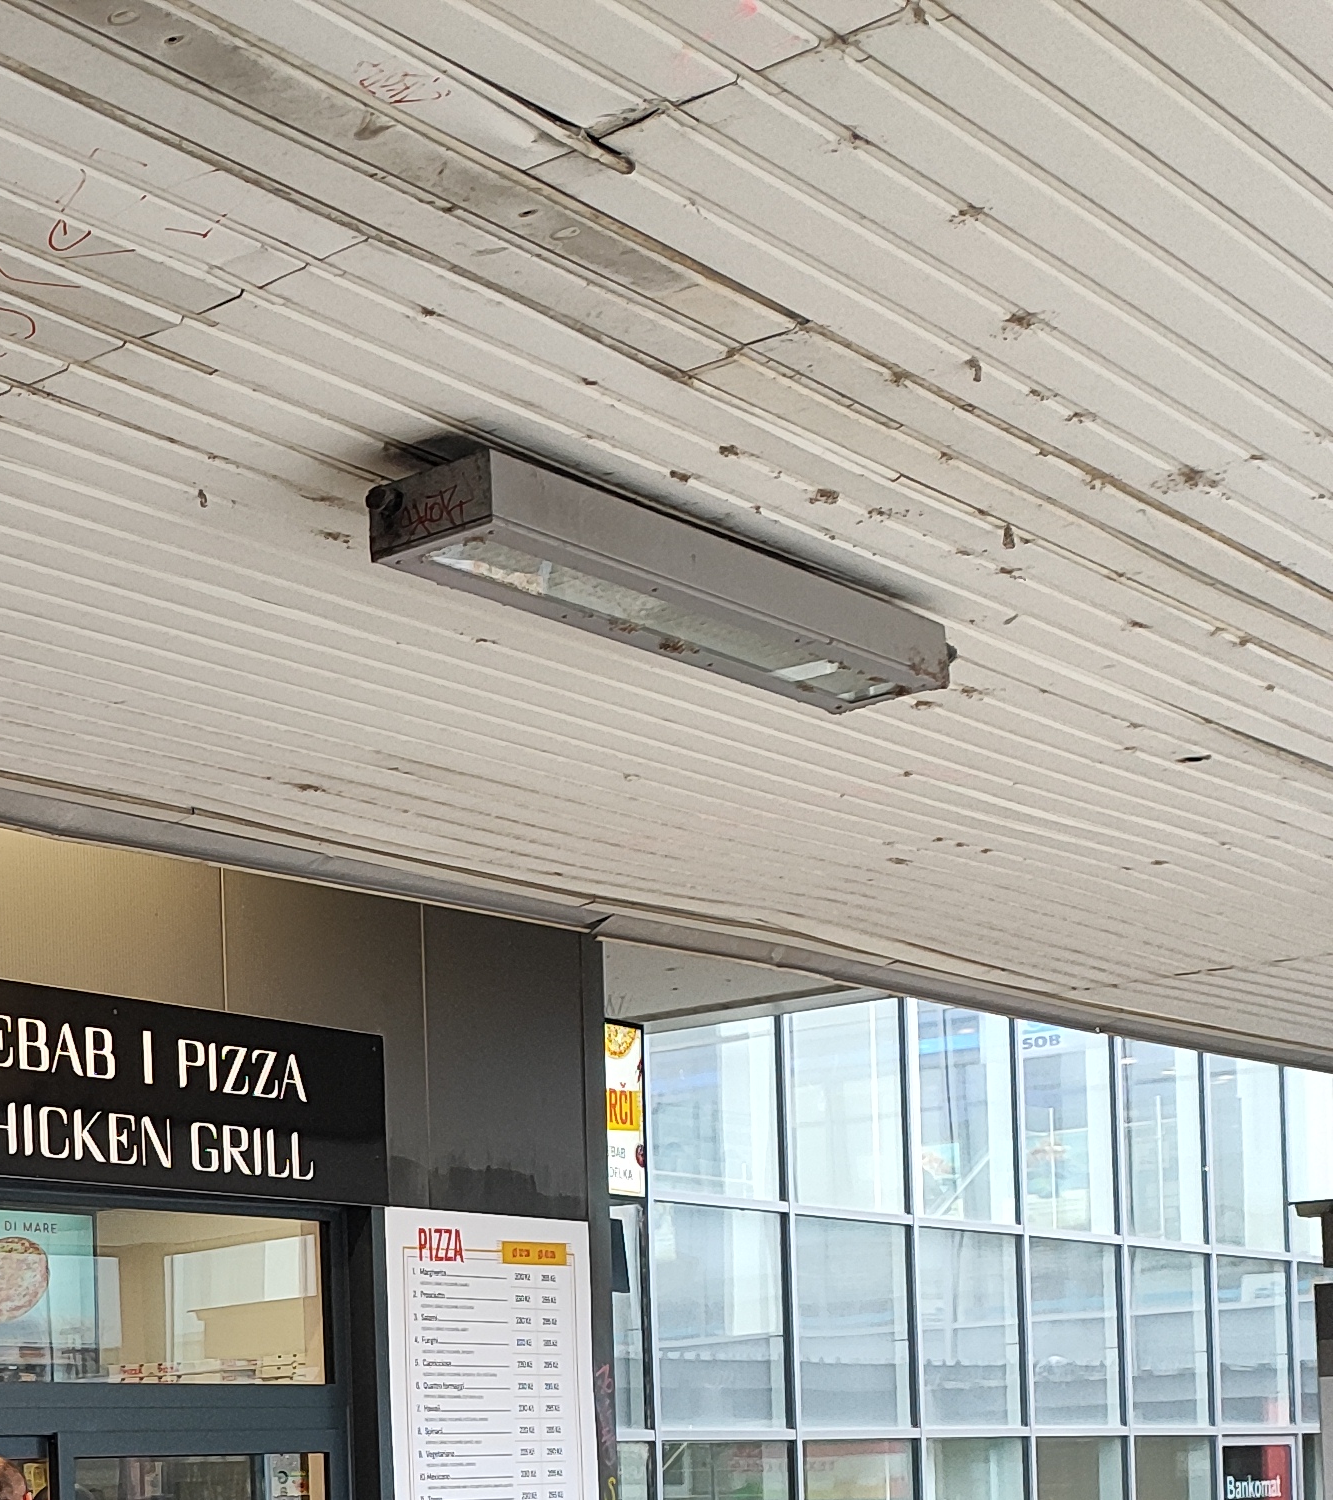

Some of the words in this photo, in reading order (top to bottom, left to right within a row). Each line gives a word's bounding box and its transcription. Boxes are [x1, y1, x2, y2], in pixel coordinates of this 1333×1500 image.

[178, 1039, 307, 1102] PIZZA
[191, 1122, 313, 1180] GRILL
[5, 1221, 16, 1231] DI
[23, 1222, 57, 1233] MARE
[418, 1228, 464, 1263] PIZZA
[1226, 1474, 1281, 1500] Bankomat
